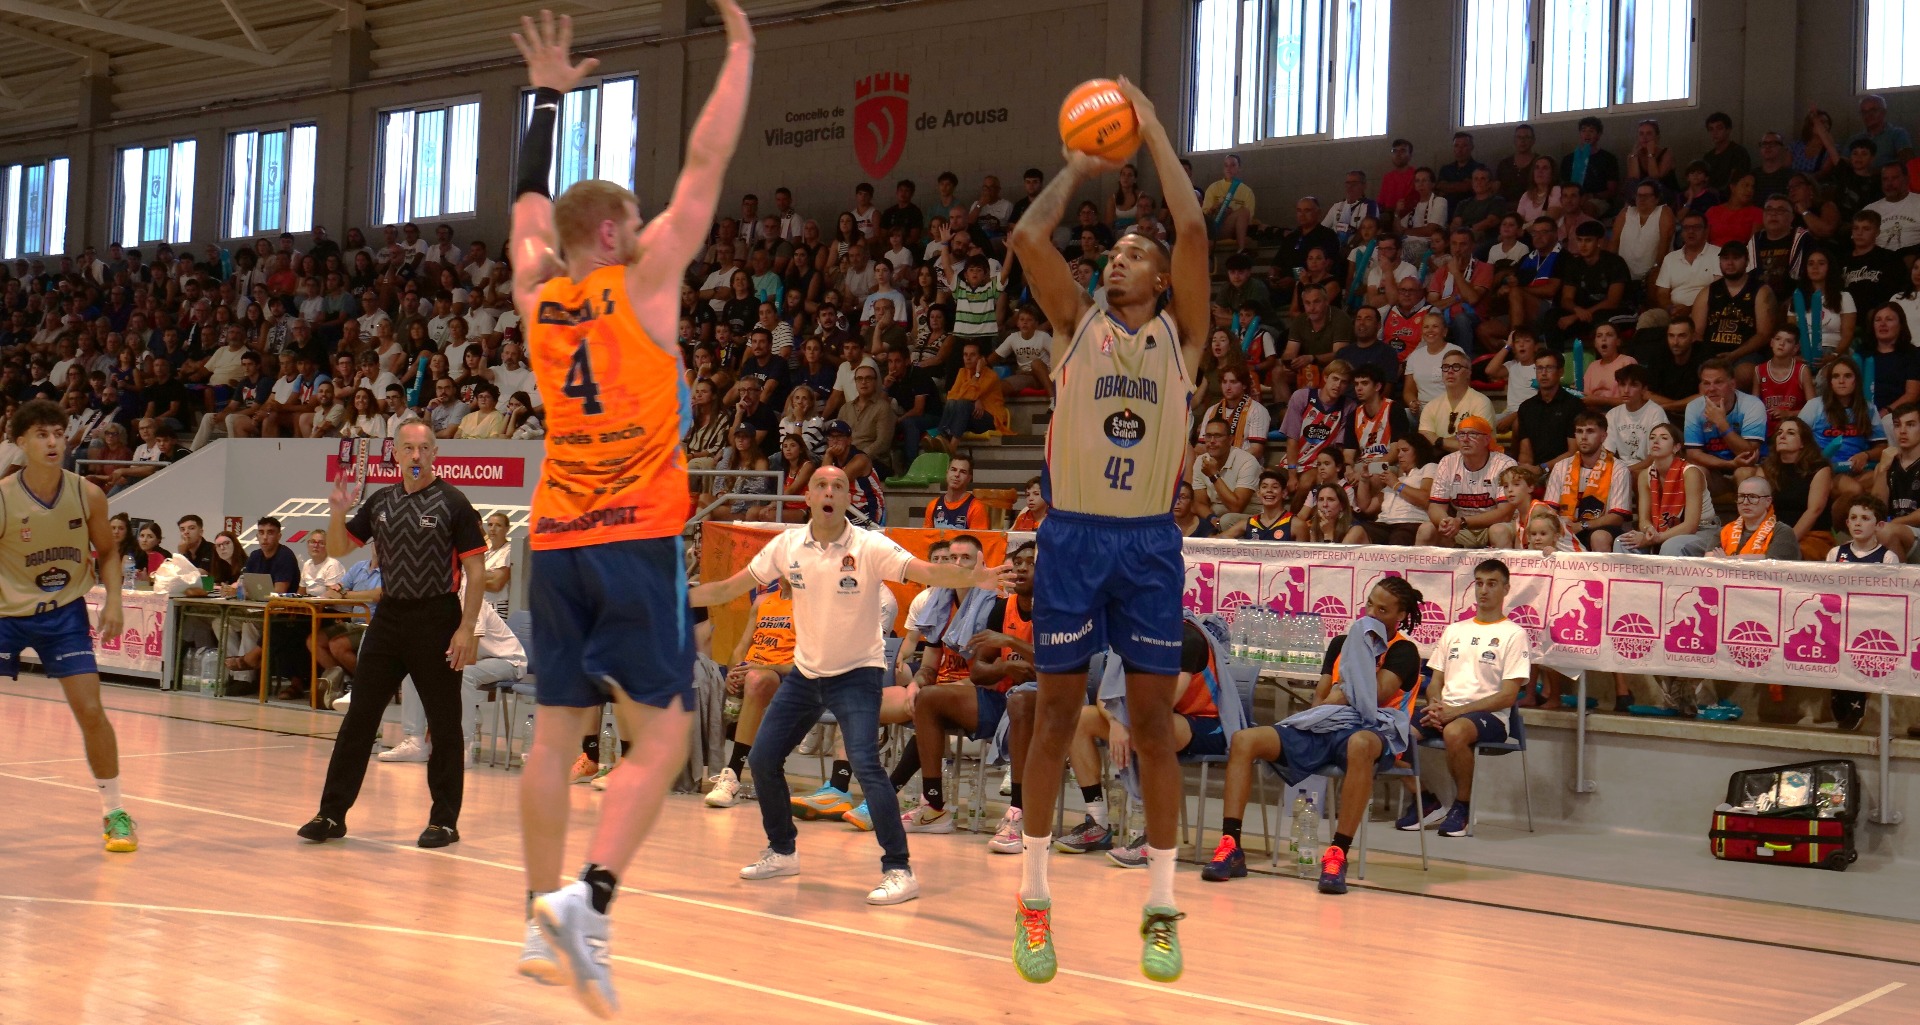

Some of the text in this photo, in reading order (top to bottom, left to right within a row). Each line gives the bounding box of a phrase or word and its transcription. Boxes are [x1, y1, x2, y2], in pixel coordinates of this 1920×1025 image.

[785, 106, 845, 123] Concello de
[764, 107, 1009, 147] Vilagarcía de Arousa
[1710, 332, 1742, 344] LAKERS
[561, 338, 604, 415] 4
[1104, 455, 1134, 491] 42
[1183, 546, 1210, 555] LWAYS
[1213, 547, 1263, 558] DIFFERENT!
[1265, 550, 1301, 559] ALWAYS
[1303, 551, 1356, 561] DIFFERENT!
[1358, 552, 1396, 562] ALWAYS
[1398, 554, 1454, 565] DIFFERENT!
[1555, 560, 1599, 571] ALWAYS
[1602, 563, 1664, 575] DIFFERENT!
[1666, 566, 1713, 578] ALWAYS
[1716, 568, 1783, 582] DIFFERENT!
[1786, 574, 1834, 585] ALWAYS
[1838, 575, 1910, 589] DIFFERENT!
[1560, 628, 1589, 641] C.B.
[1676, 636, 1704, 650] C.B.
[1666, 653, 1715, 664] VILAGARCÍA
[1796, 645, 1827, 658] C.B.
[1785, 662, 1838, 673] VILAGARCÍA
